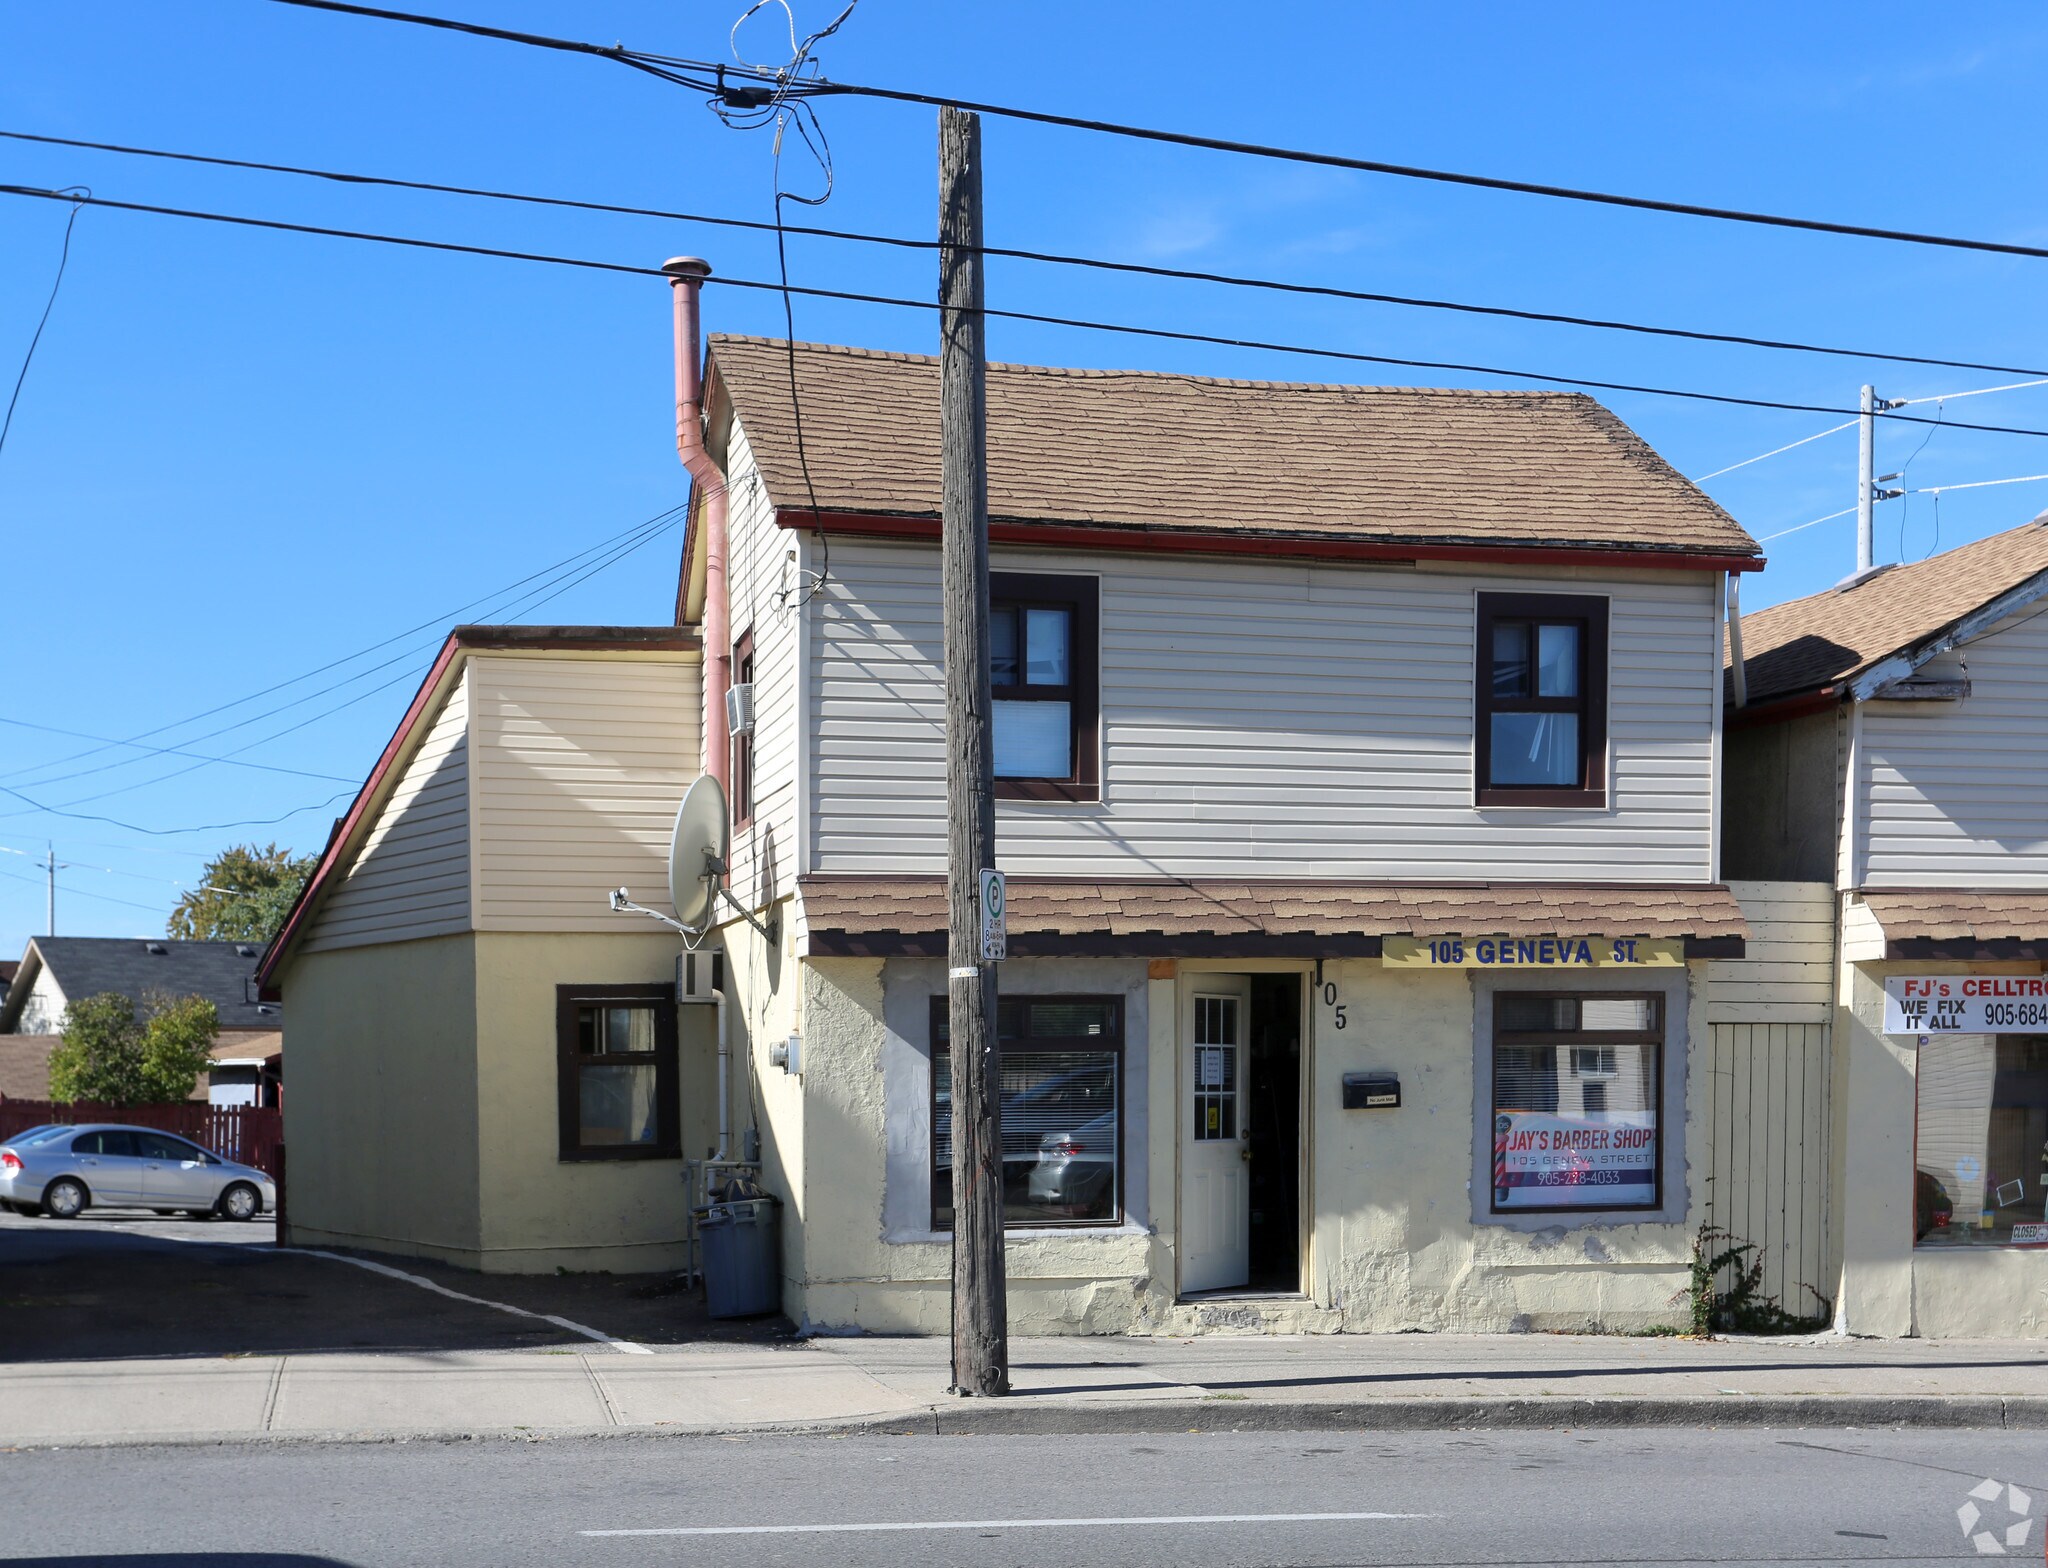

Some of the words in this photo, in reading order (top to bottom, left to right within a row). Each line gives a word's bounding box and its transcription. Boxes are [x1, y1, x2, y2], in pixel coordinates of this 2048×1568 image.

[1428, 941, 1464, 964] 105
[1475, 939, 1593, 964] GENEVA
[1613, 939, 1639, 963] ST.
[1904, 979, 1950, 997] FJ's
[1962, 979, 2048, 997] CELLTR
[1900, 1000, 1928, 1015] WE
[1937, 1000, 1966, 1014] FIX
[1906, 1015, 1922, 1029] IT
[1928, 1015, 1961, 1029] ALL
[1509, 1130, 1549, 1151] JAY'S
[1552, 1129, 1610, 1150] BARBER
[1612, 1128, 1653, 1149] SHOP
[1512, 1156, 1537, 1166] 105
[1542, 1155, 1596, 1165] GENEVA
[1600, 1154, 1650, 1164] STREET
[2012, 1225, 2038, 1238] CLOSED
